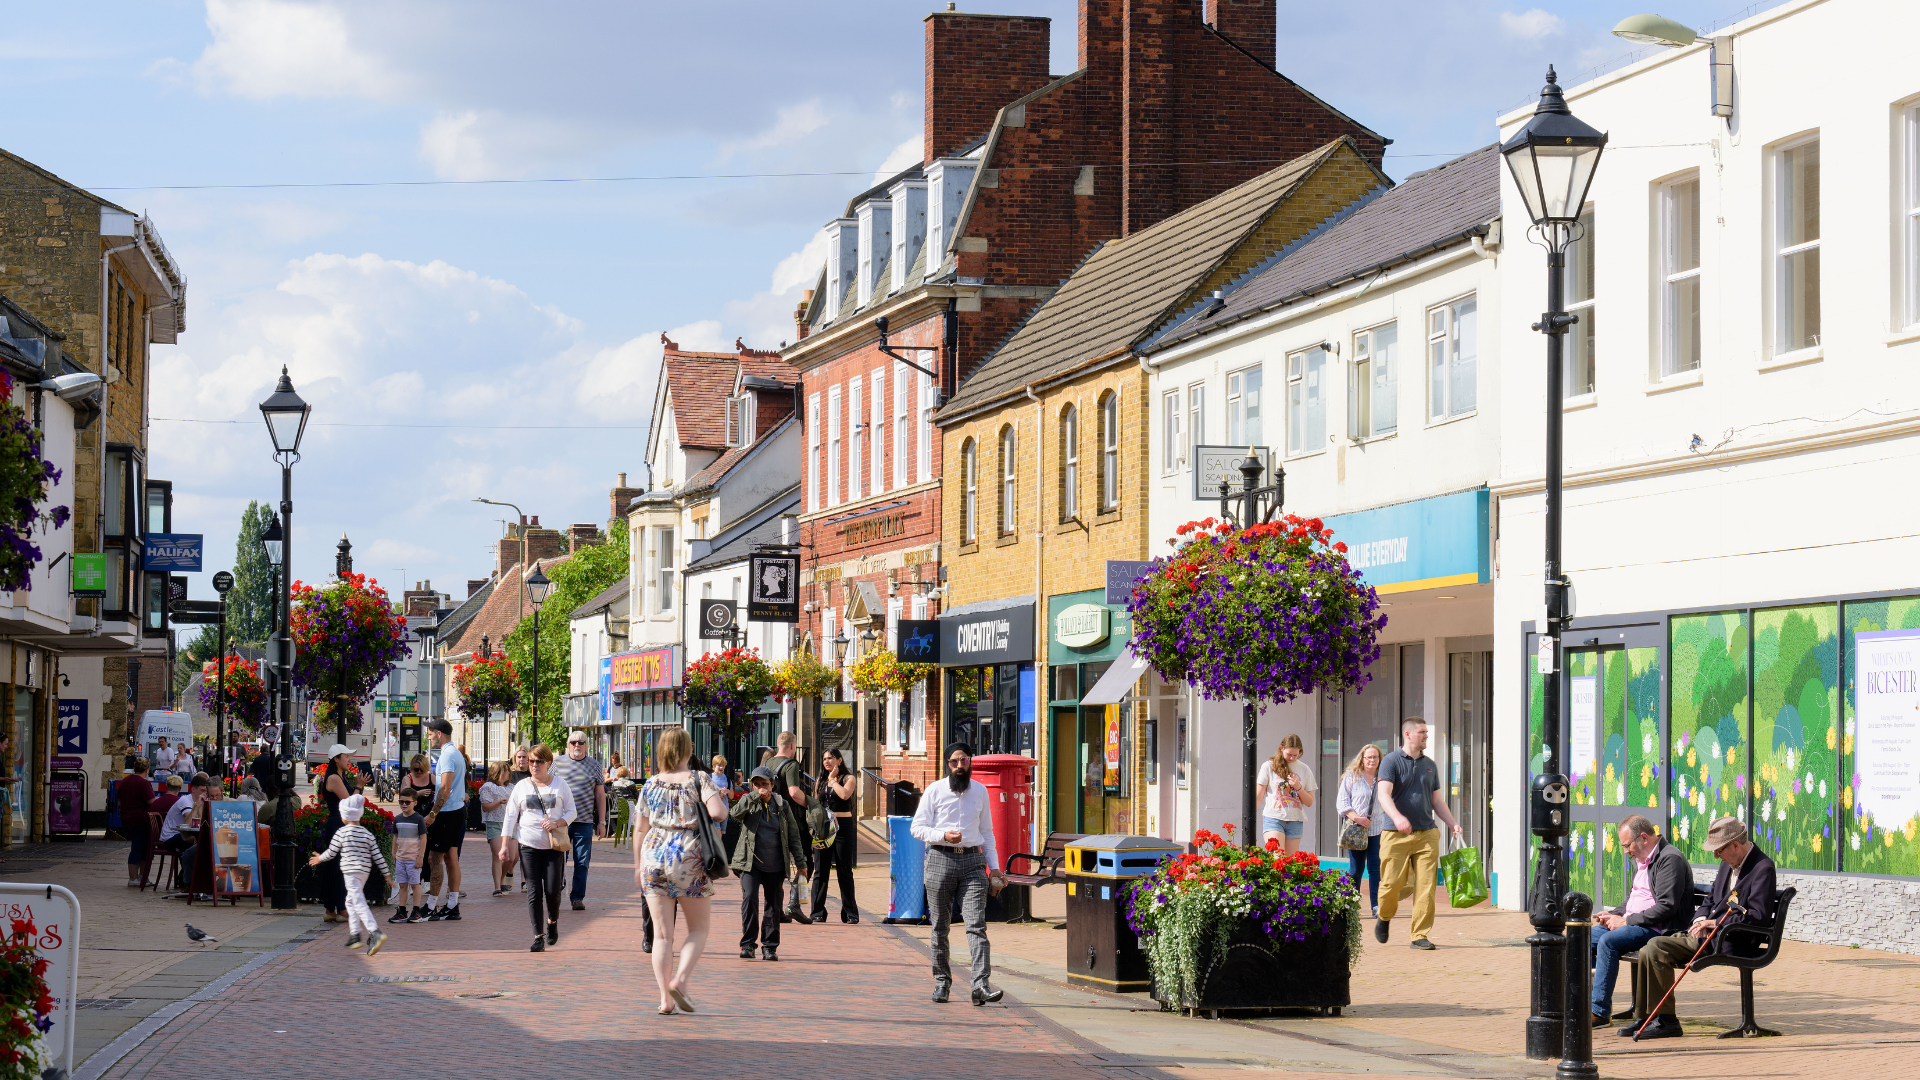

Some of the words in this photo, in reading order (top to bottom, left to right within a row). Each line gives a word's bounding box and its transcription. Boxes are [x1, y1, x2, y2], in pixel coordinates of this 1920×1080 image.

[1206, 457, 1244, 472] SALO
[858, 517, 881, 544] PENNY
[881, 511, 905, 538] BLACK
[147, 547, 200, 558] HALIFAX
[1348, 542, 1370, 570] VALUE
[1371, 536, 1408, 567] EVERYDAY
[1110, 564, 1150, 578] SALO
[957, 620, 996, 654] COVENTRY
[996, 635, 1008, 652] Society
[614, 656, 643, 687] BICESTER
[643, 654, 660, 683] TOYS
[1867, 669, 1917, 694] BICESTER
[1109, 730, 1118, 743] BIG
[1109, 750, 1118, 760] SALE
[214, 817, 253, 832] iceberg
